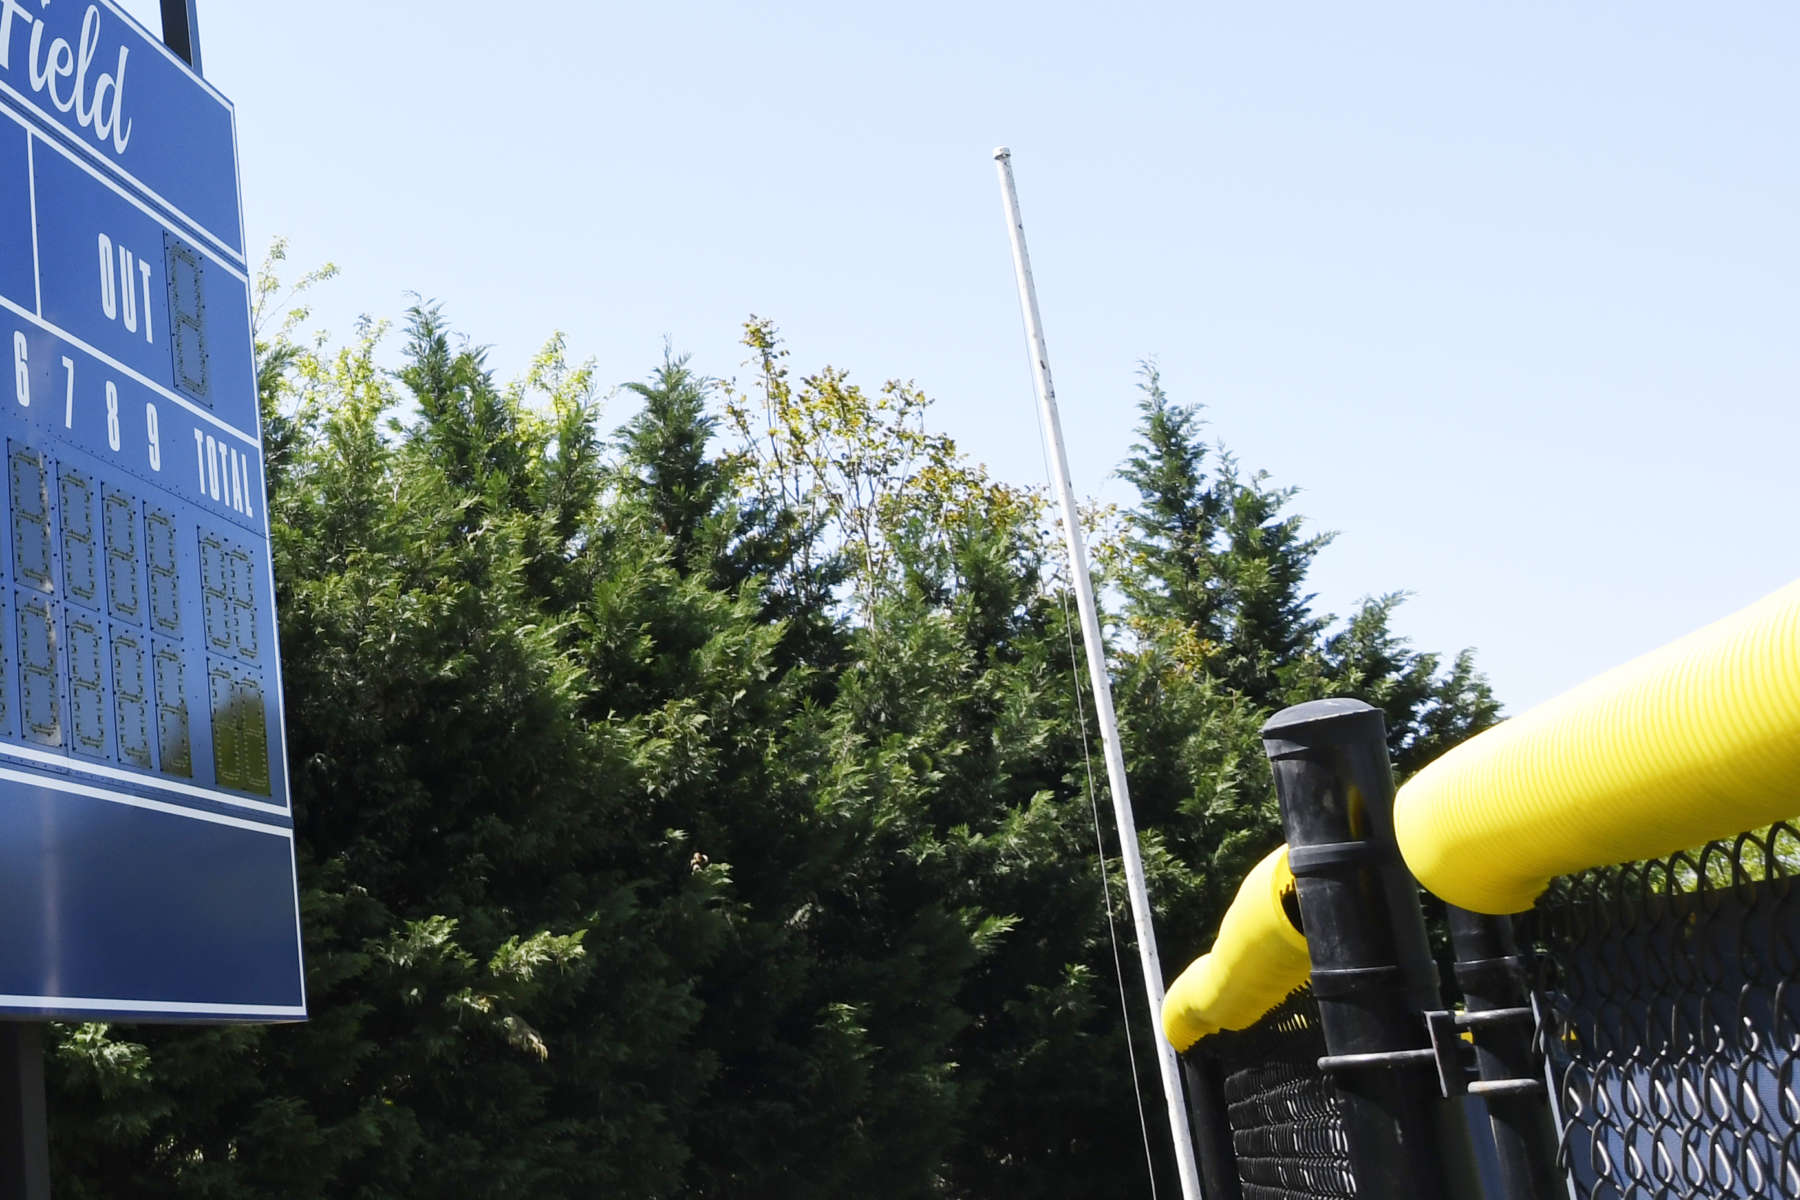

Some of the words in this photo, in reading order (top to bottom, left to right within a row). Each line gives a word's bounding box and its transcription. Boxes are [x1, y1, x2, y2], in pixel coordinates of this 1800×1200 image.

[98, 232, 153, 344] OUT
[13, 330, 31, 408] 6
[61, 355, 74, 429] 7
[105, 380, 121, 452] 8
[146, 402, 161, 472] 9
[193, 427, 254, 519] TOTAL
